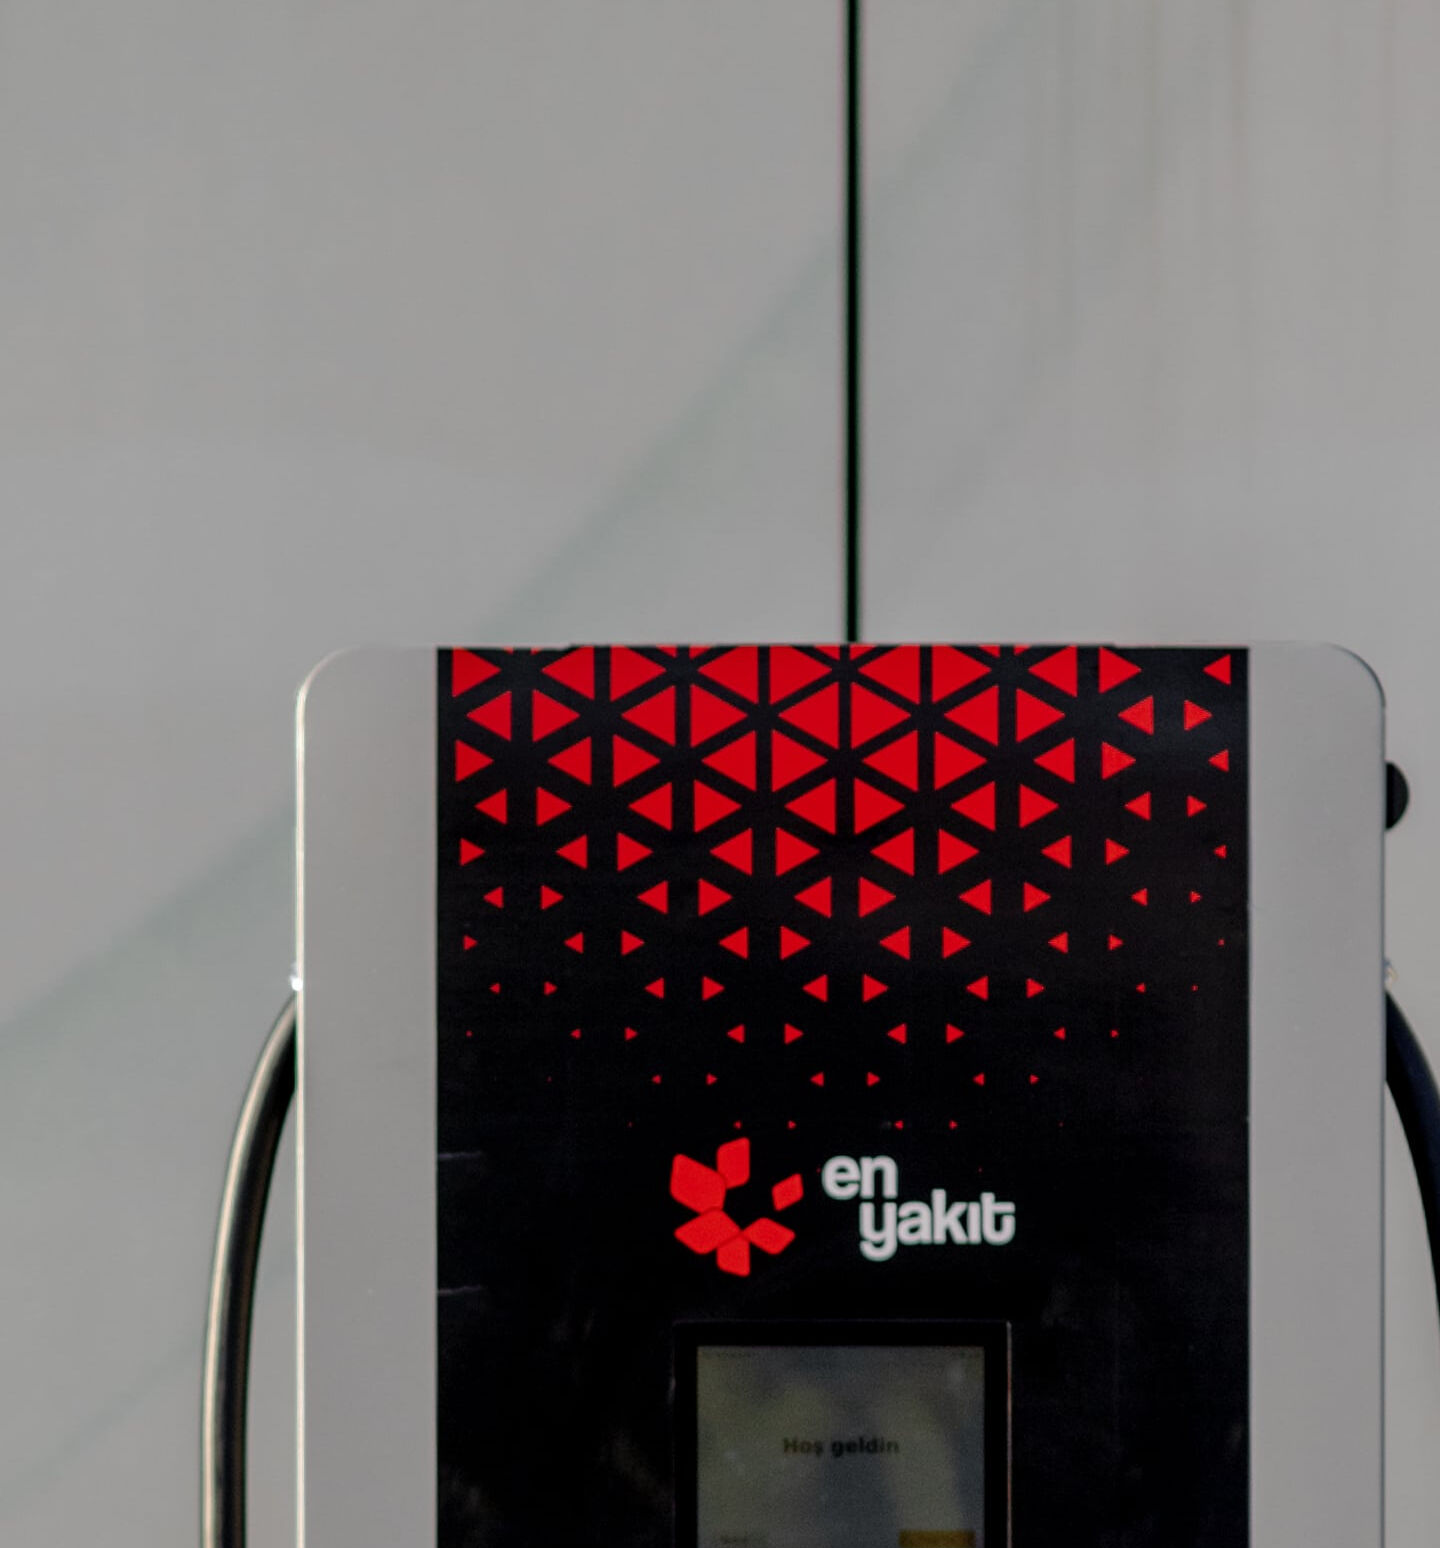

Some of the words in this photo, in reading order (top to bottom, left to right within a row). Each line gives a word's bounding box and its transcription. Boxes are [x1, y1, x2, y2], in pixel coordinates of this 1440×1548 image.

[821, 1155, 898, 1200] en
[859, 1188, 1016, 1262] yakıt
[831, 1436, 900, 1458] geldin
